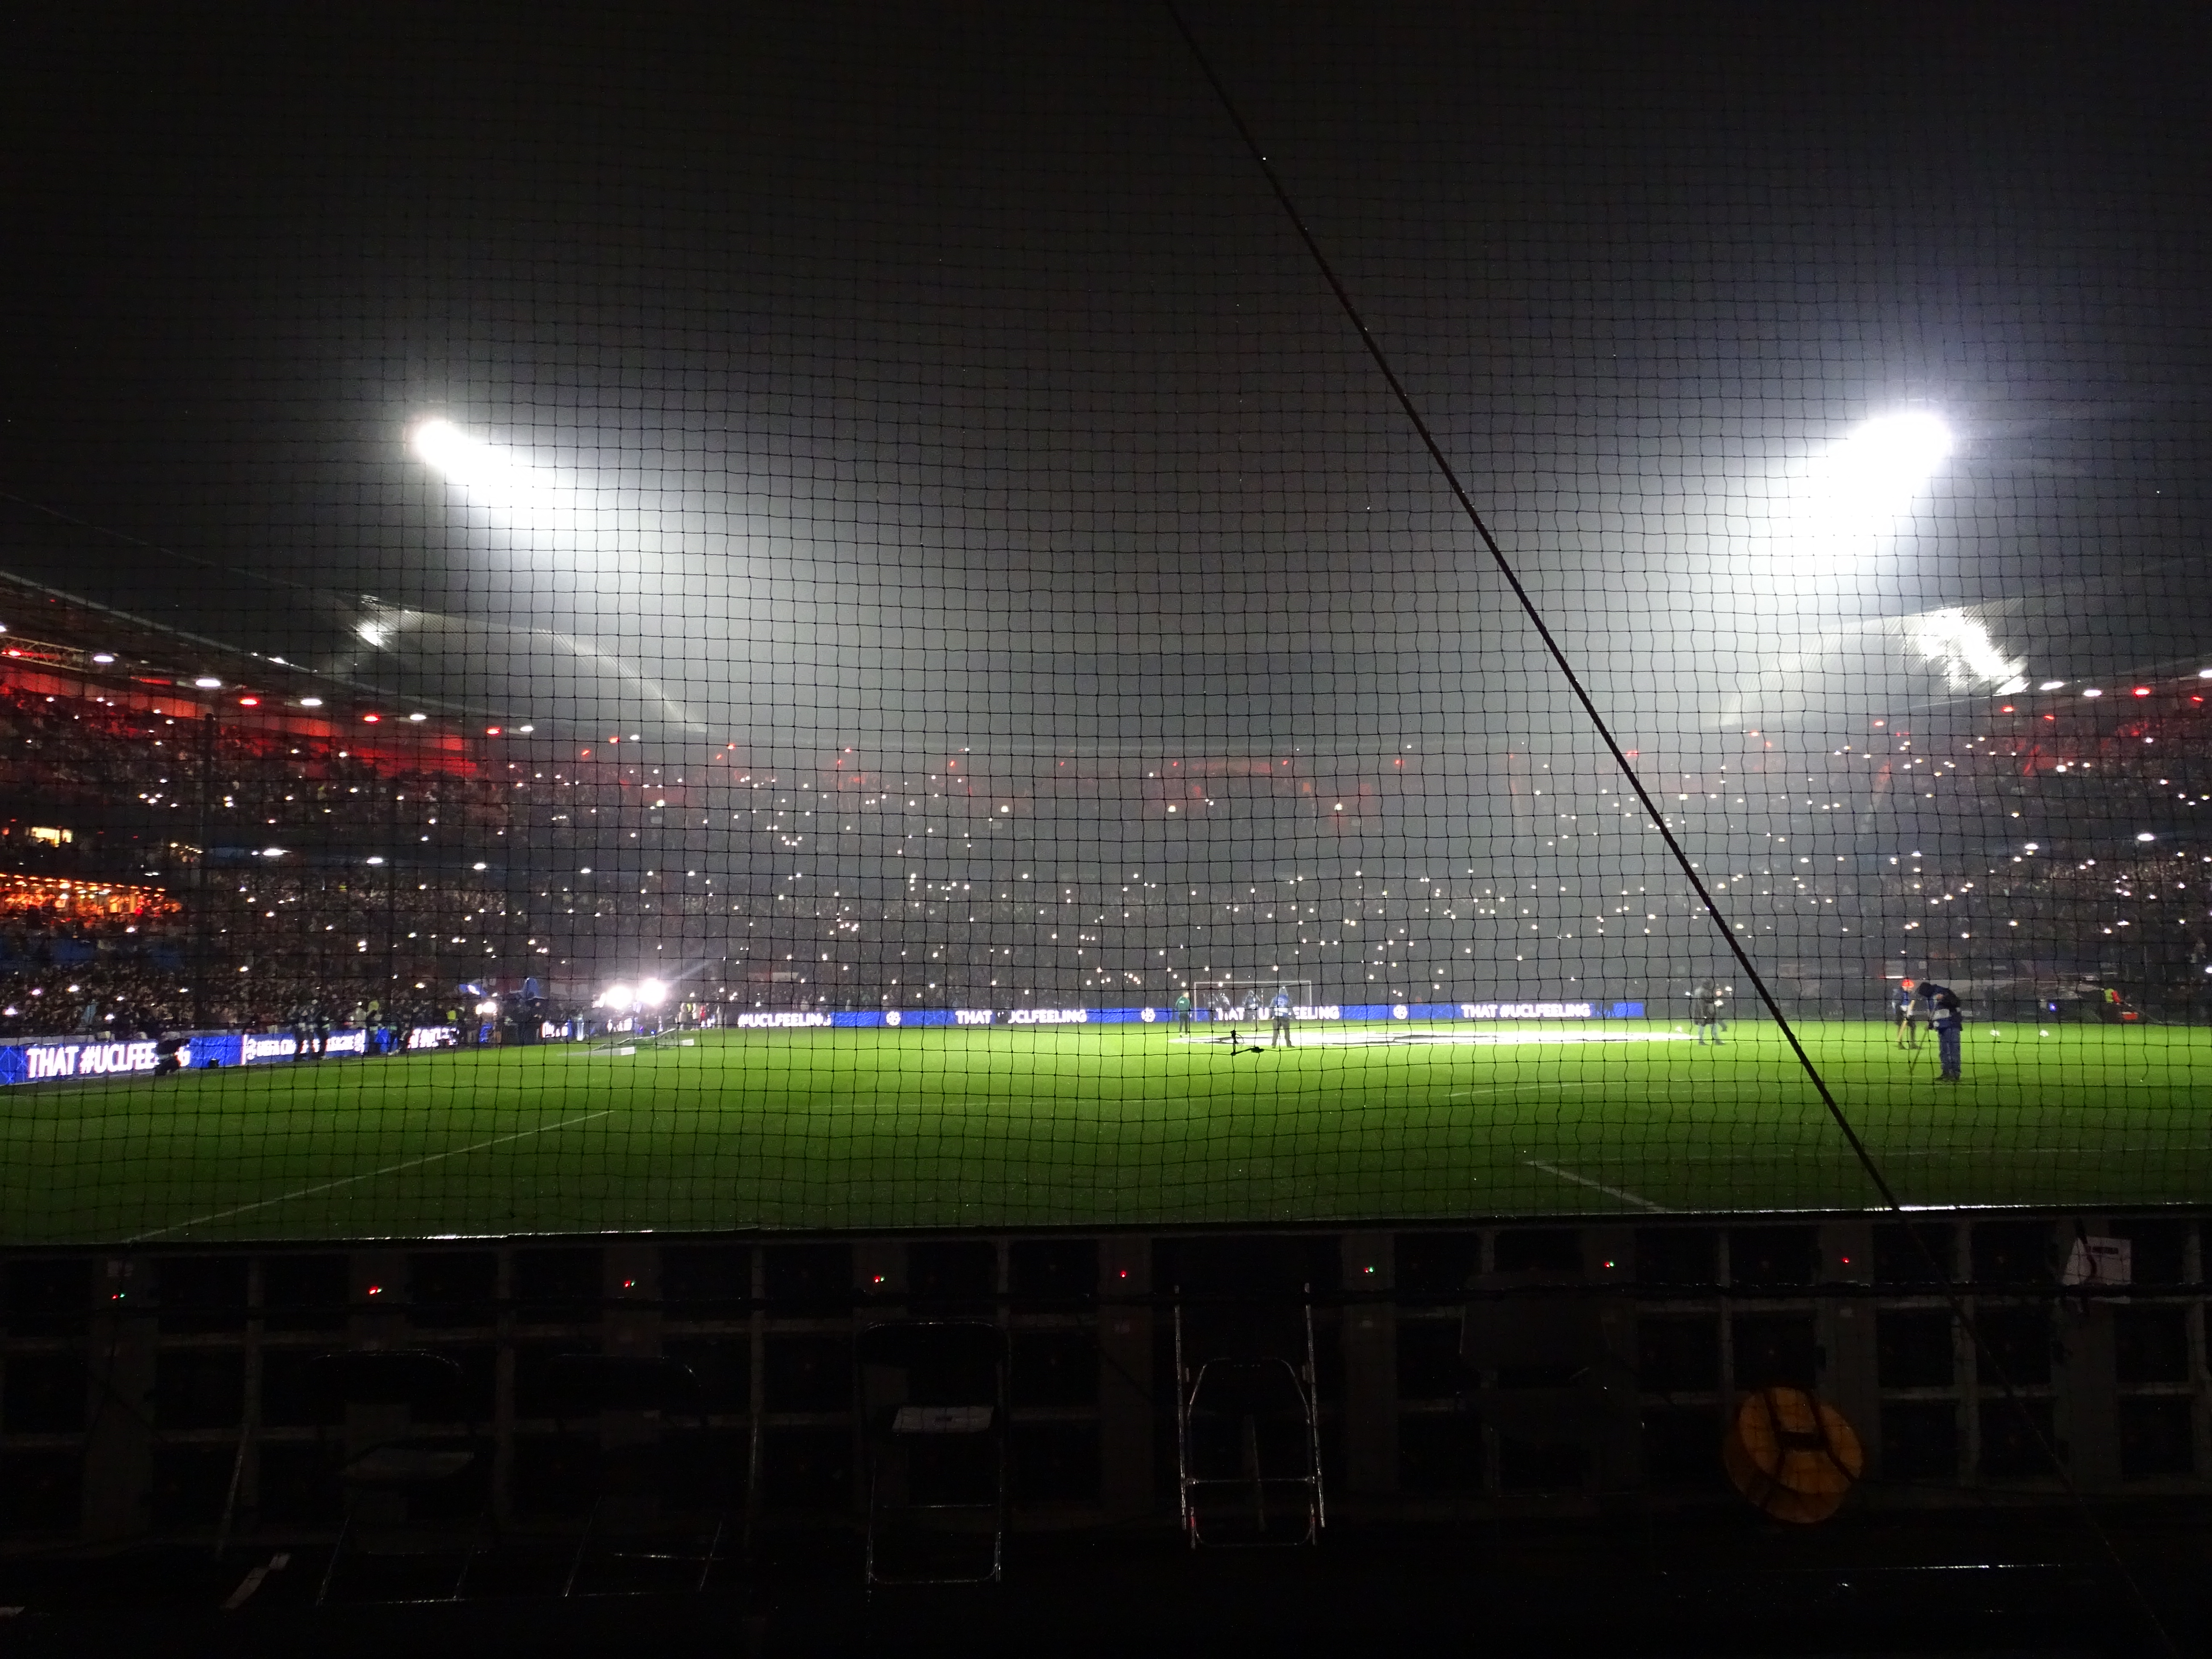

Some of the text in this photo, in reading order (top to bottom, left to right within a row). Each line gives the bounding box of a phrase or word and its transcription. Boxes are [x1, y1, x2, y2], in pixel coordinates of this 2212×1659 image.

[955, 1010, 1087, 1024] THAT UCLFEELING
[1461, 1003, 1590, 1018] THAT #UCLFEELING
[27, 1042, 190, 1078] THAT #UCLFEEG
